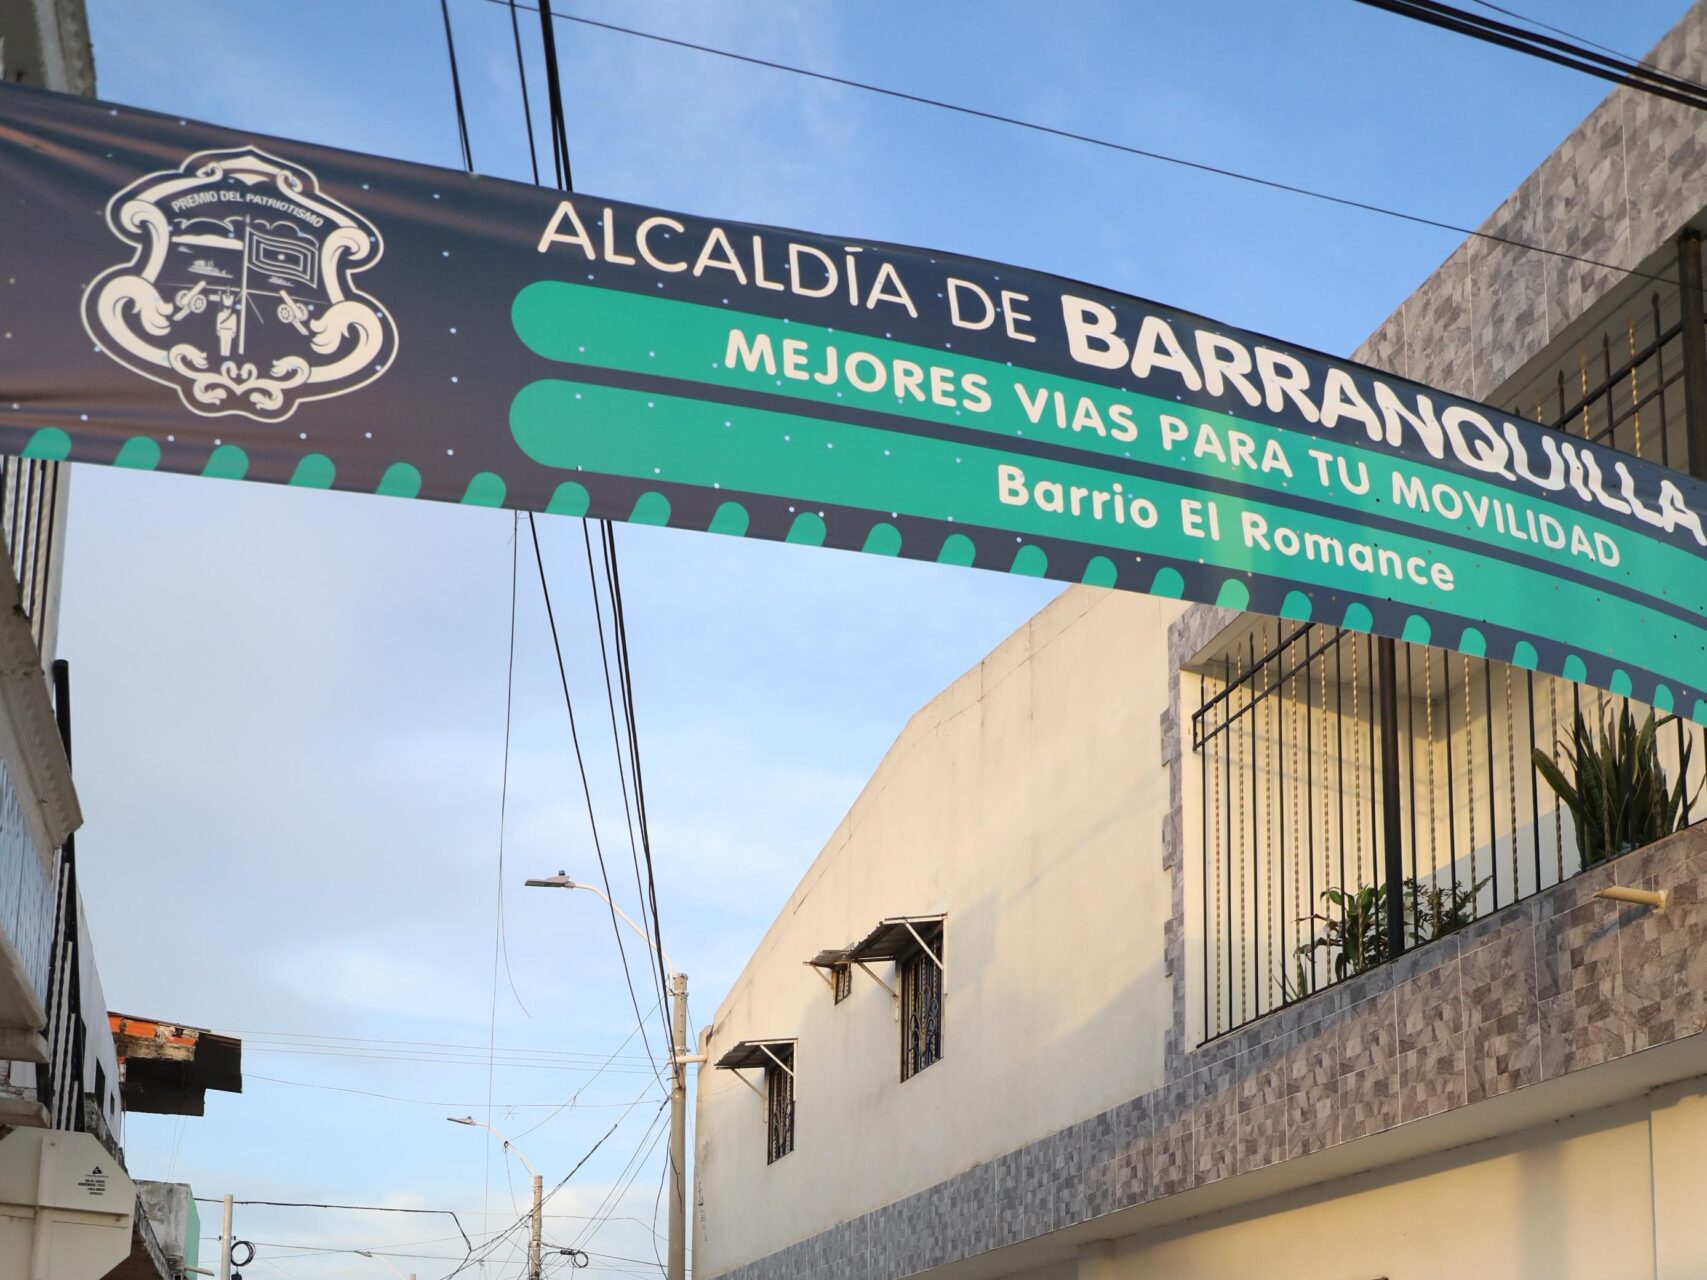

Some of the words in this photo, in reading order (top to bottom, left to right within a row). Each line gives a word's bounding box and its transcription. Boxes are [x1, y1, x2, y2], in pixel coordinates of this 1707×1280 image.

[171, 190, 218, 212] PREMIO
[220, 190, 243, 202] DEL
[246, 193, 324, 228] PATRIOTISMO
[538, 201, 918, 318] ALCALDÍA
[947, 277, 1037, 343] DE
[1060, 295, 1707, 547] BARRANQUILLA
[725, 328, 993, 413] MEJORES
[1013, 382, 1139, 442] VIAS
[1160, 413, 1294, 478] PARA
[1309, 449, 1370, 495] TU
[1392, 470, 1621, 568] MOVILIDAD
[997, 463, 1159, 529] Barrio
[1181, 498, 1221, 541] El
[1241, 510, 1455, 592] Romance
